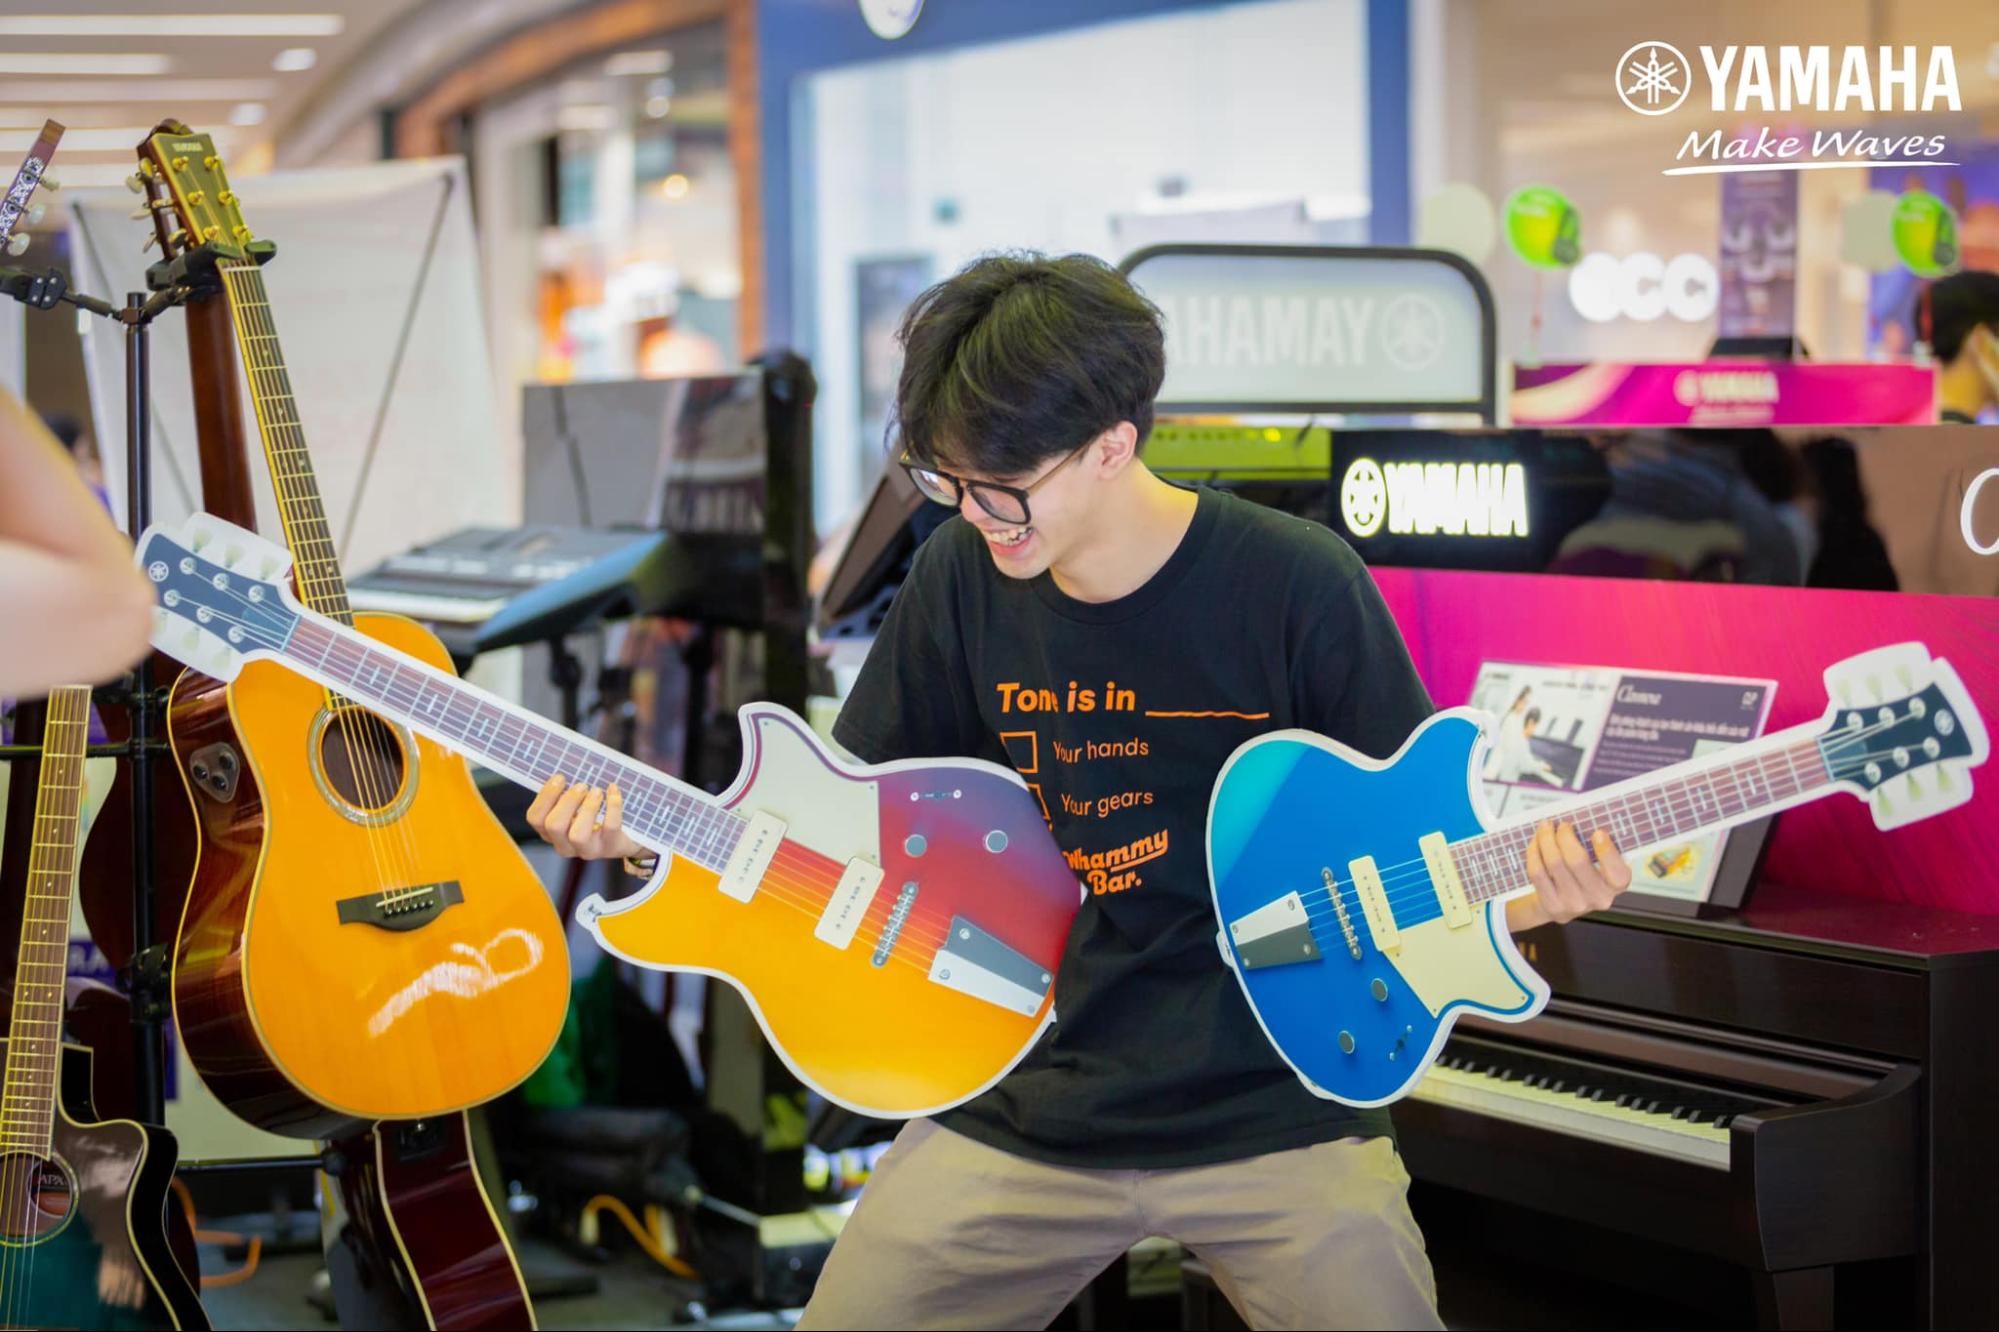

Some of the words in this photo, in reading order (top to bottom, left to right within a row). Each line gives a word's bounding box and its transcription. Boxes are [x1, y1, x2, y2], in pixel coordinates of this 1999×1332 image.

[1383, 462, 1528, 537] YAMAHA
[1067, 681, 1096, 712] is
[1105, 681, 1136, 711] in
[1052, 740, 1082, 764] Your
[1086, 737, 1149, 760] hands
[1097, 791, 1154, 818] gears
[1086, 869, 1142, 896] Bar.
